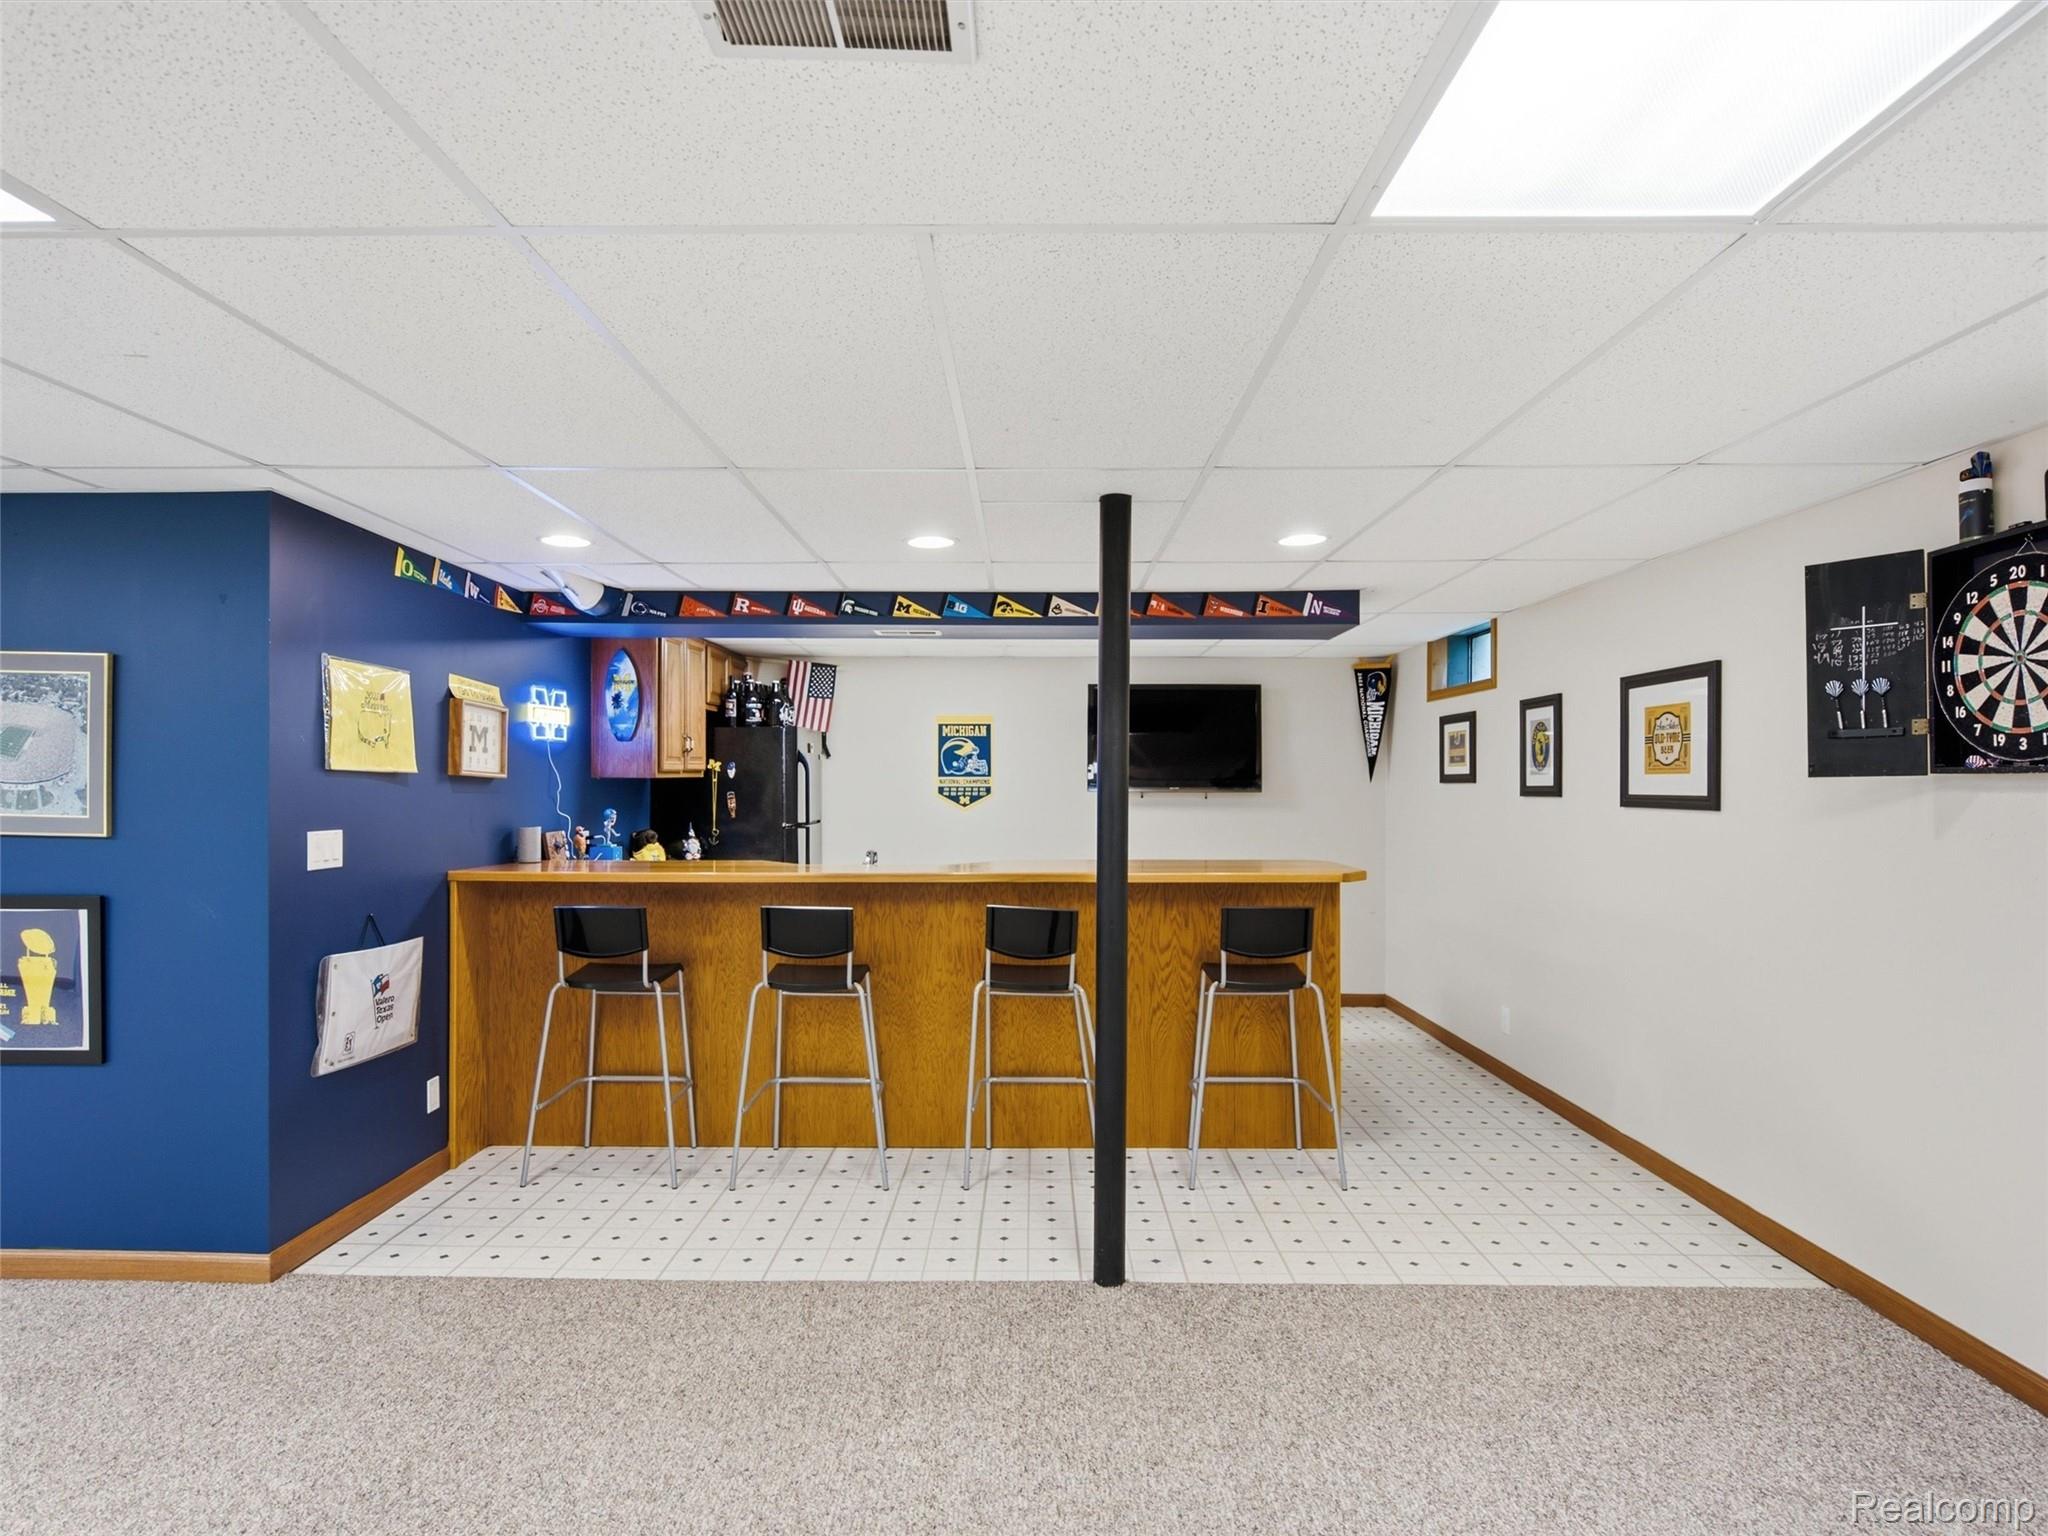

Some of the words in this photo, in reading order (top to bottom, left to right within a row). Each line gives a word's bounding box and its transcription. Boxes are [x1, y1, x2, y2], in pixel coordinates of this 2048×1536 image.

[2009, 565, 2026, 580] 20
[2040, 564, 2045, 578] 1
[1990, 573, 1998, 587] 5
[1966, 591, 1979, 604] 12
[735, 597, 750, 613] R
[895, 601, 912, 614] M
[1310, 599, 1323, 615] N
[1953, 612, 1962, 624] 9
[1942, 636, 1954, 649] 14
[1941, 660, 1951, 673] 11
[1946, 684, 1954, 697] 8
[1955, 706, 1967, 719] 16
[942, 725, 987, 737] MICHIGAN
[1973, 723, 1982, 737] 7
[469, 724, 489, 753] M
[1993, 734, 2006, 747] 19
[2019, 737, 2028, 751] 3
[376, 1004, 395, 1014] Texas
[376, 1013, 394, 1024] Open
